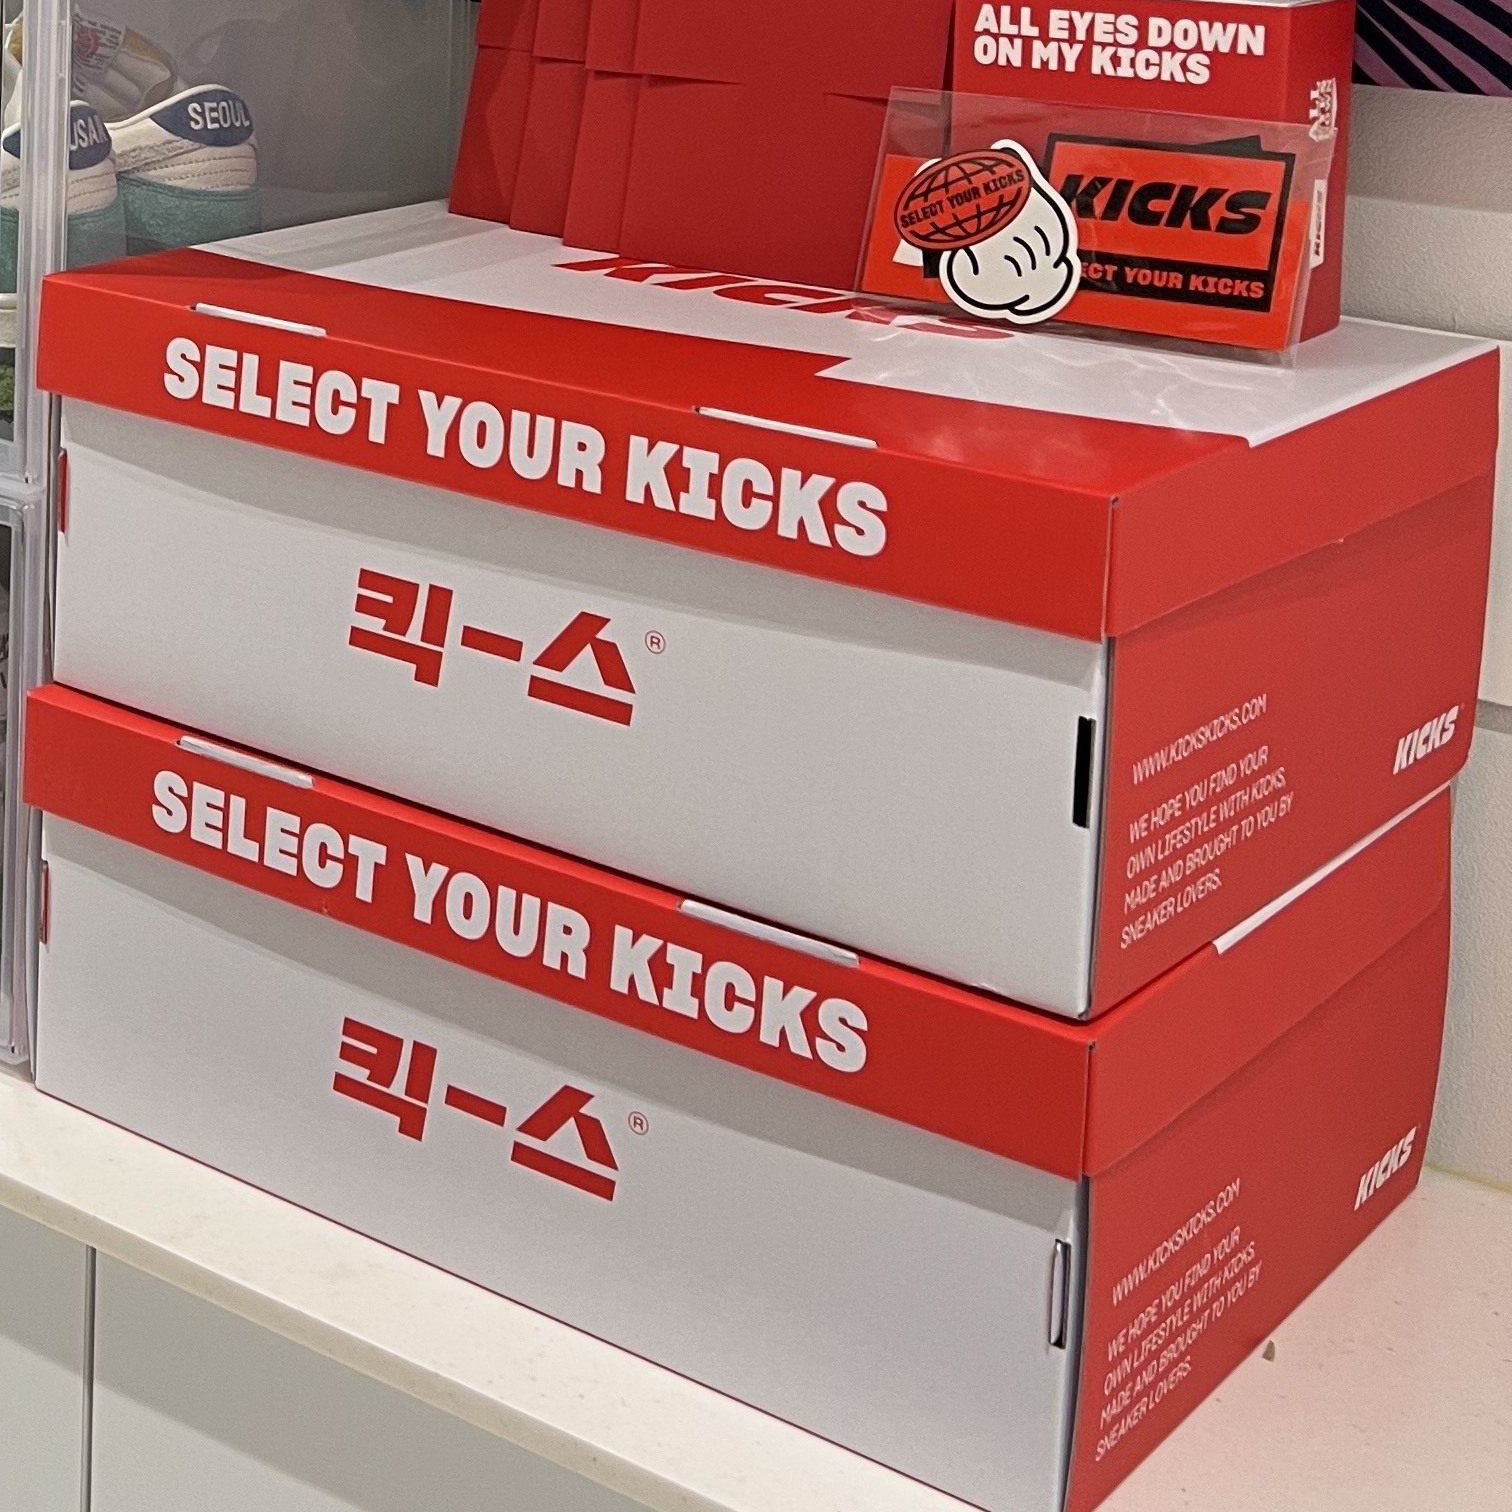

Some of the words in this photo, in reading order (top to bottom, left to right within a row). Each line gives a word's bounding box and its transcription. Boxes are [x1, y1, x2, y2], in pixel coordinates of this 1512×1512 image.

[973, 36, 1022, 68] ON
[1031, 41, 1082, 74] MY
[1091, 46, 1211, 85] KICKS
[974, 4, 1039, 36] ALL
[1048, 11, 1138, 46] EYES
[1147, 17, 1266, 56] DOWN
[188, 99, 250, 131] SEOUL
[900, 199, 945, 229] SELECT
[947, 186, 982, 209] YOUR
[983, 168, 1025, 195] KICKS
[1059, 174, 1273, 235] KICKS
[1124, 266, 1184, 289] YOUR
[1189, 274, 1265, 299] KICKS
[163, 337, 402, 446] SELECT
[417, 390, 606, 494] YOUR
[625, 436, 888, 557] KICKS
[1132, 693, 1267, 785] WWW.KICKSKICKS.COM
[1392, 705, 1460, 776] KICKS
[1126, 843, 1156, 879] OWN
[1157, 806, 1217, 861] LIFESTYLE
[1219, 786, 1250, 822] WITH
[1129, 813, 1149, 844] WE
[1150, 793, 1183, 831] HOPE
[1184, 779, 1208, 810] YOU
[1208, 763, 1238, 797] FIND
[1239, 745, 1269, 778] YOUR
[1124, 874, 1158, 915] MADE
[1158, 859, 1184, 892] AND
[1185, 825, 1238, 875] BROUGHT
[1241, 815, 1255, 841] TO
[1256, 800, 1278, 830] YOU
[1278, 791, 1294, 817] BY
[151, 770, 386, 904] SELECT
[403, 851, 591, 981] YOUR
[609, 925, 869, 1074] KICKS
[1120, 897, 1176, 949] SNEAKER
[1353, 1126, 1417, 1211] KICKS
[1104, 1353, 1133, 1396] OWN
[1133, 1298, 1192, 1369] LIFESTYLE
[1193, 1271, 1222, 1312] WITH
[1107, 1328, 1127, 1362] WE
[1128, 1298, 1160, 1343] HOPE
[1161, 1277, 1184, 1313] YOU
[1184, 1253, 1211, 1292] FIND
[1213, 1225, 1241, 1265] YOUR
[1100, 1381, 1133, 1430] MADE
[1133, 1359, 1158, 1398] AND
[1159, 1309, 1211, 1373] BROUGHT
[1212, 1296, 1225, 1322] TO
[1226, 1273, 1248, 1308] YOU
[1248, 1260, 1263, 1288] BY
[1095, 1397, 1148, 1463] SNEAKER
